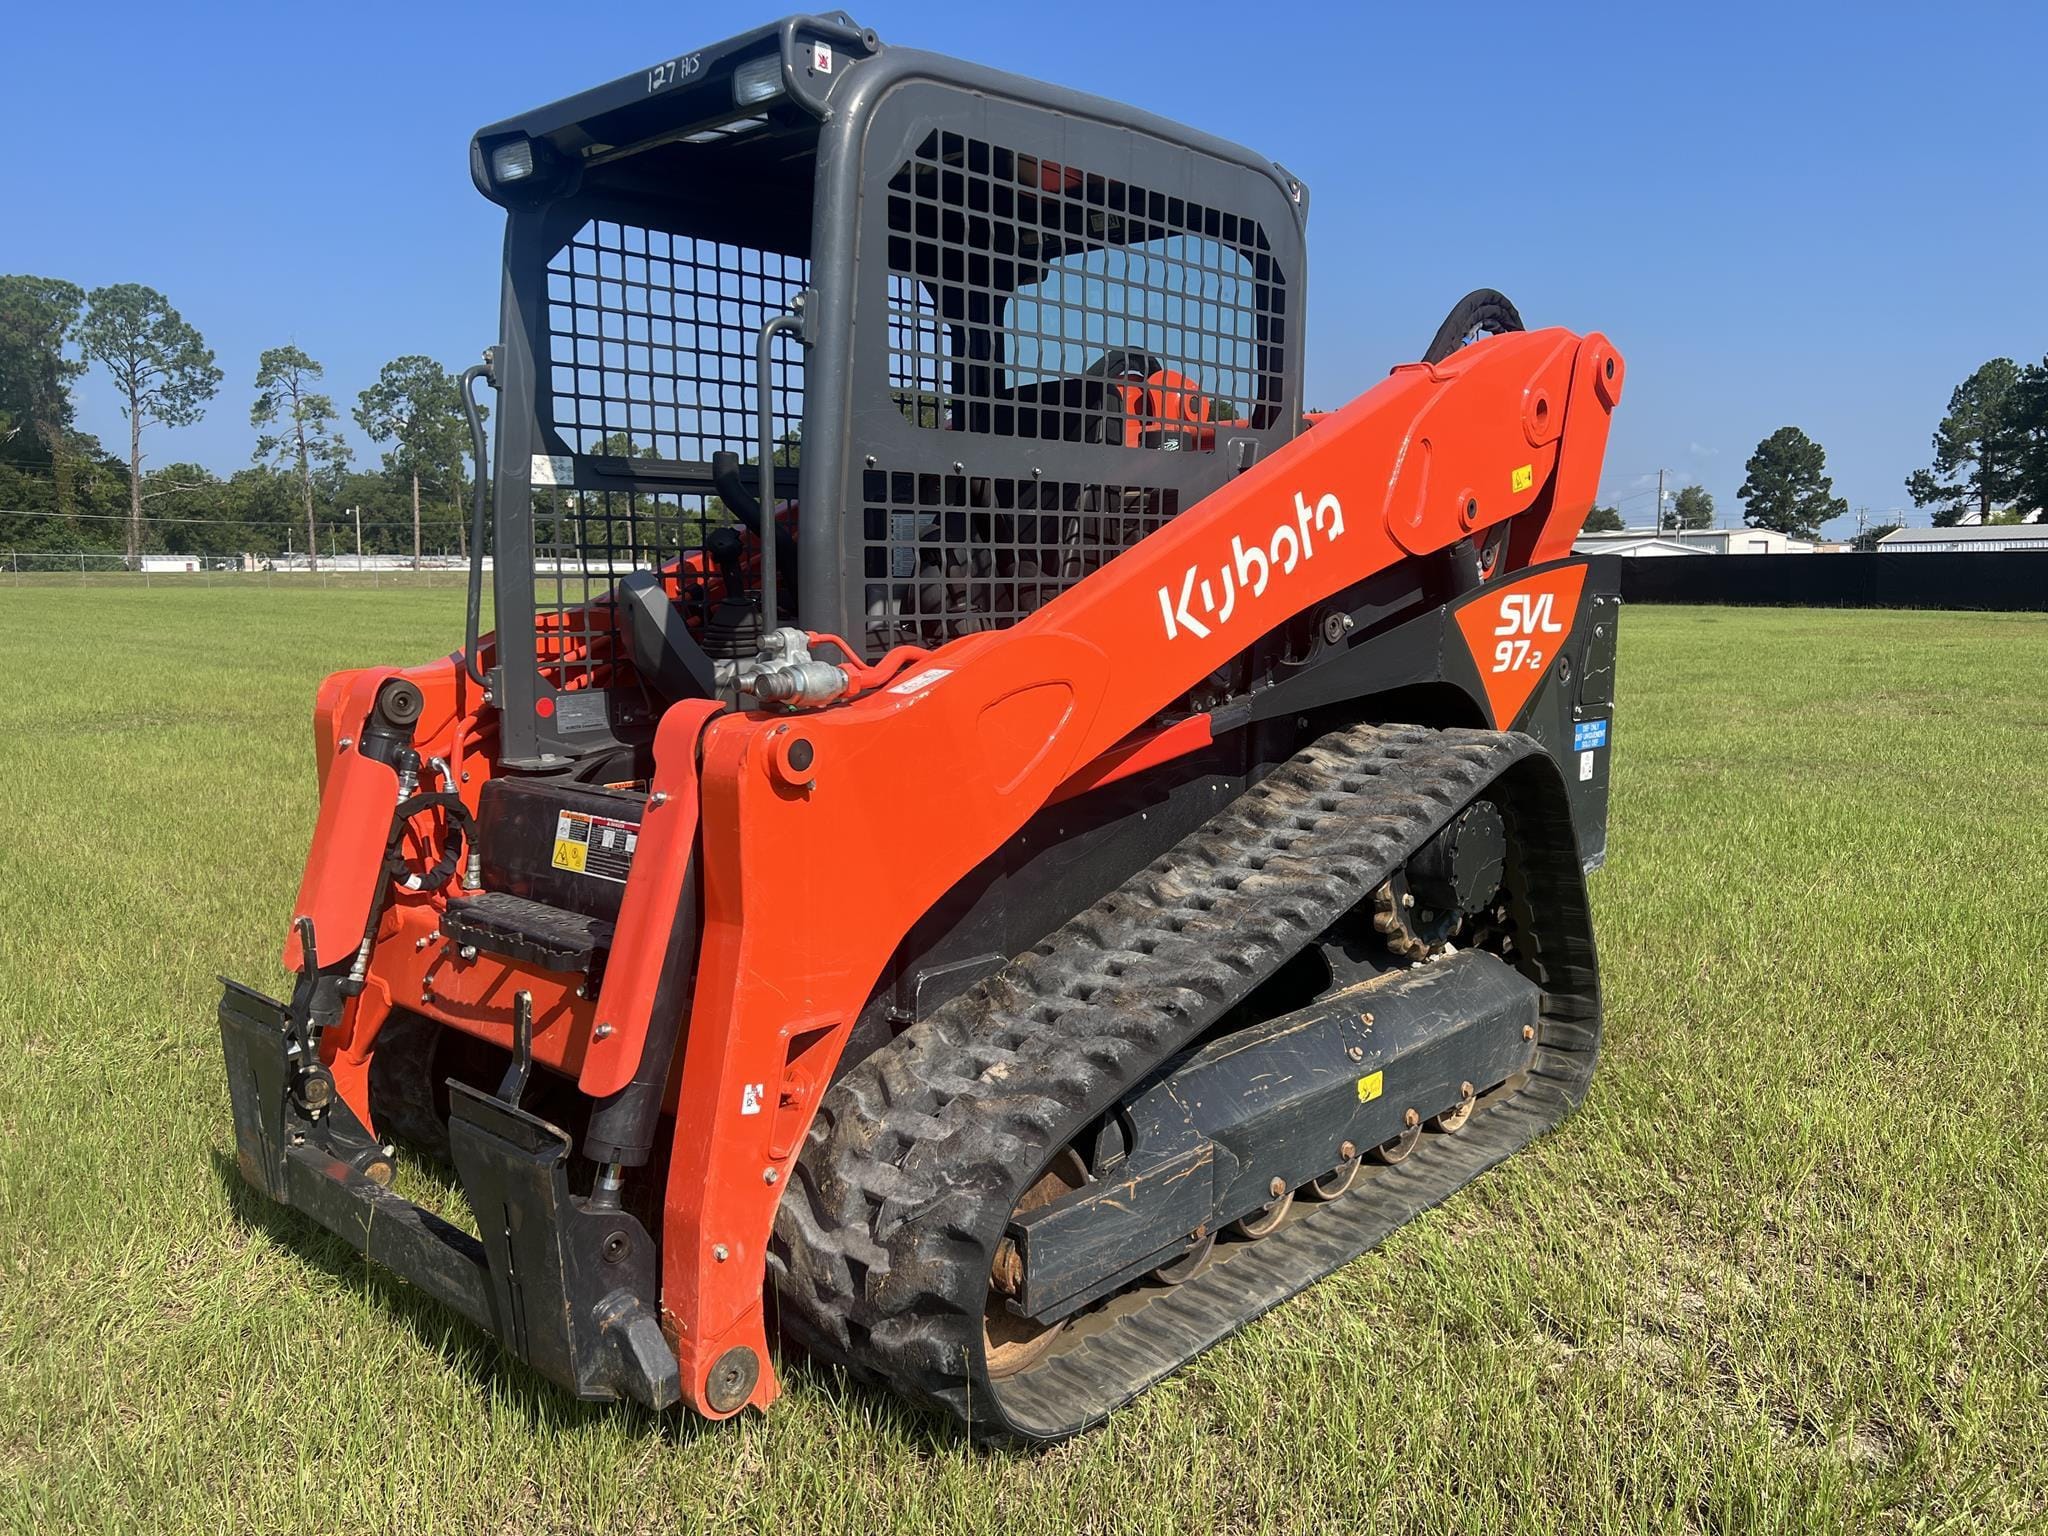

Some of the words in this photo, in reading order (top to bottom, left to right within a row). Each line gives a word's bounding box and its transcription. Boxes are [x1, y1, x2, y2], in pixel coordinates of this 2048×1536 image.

[648, 61, 676, 93] 127
[1158, 491, 1345, 641] Kubota
[1494, 594, 1563, 636] SVL
